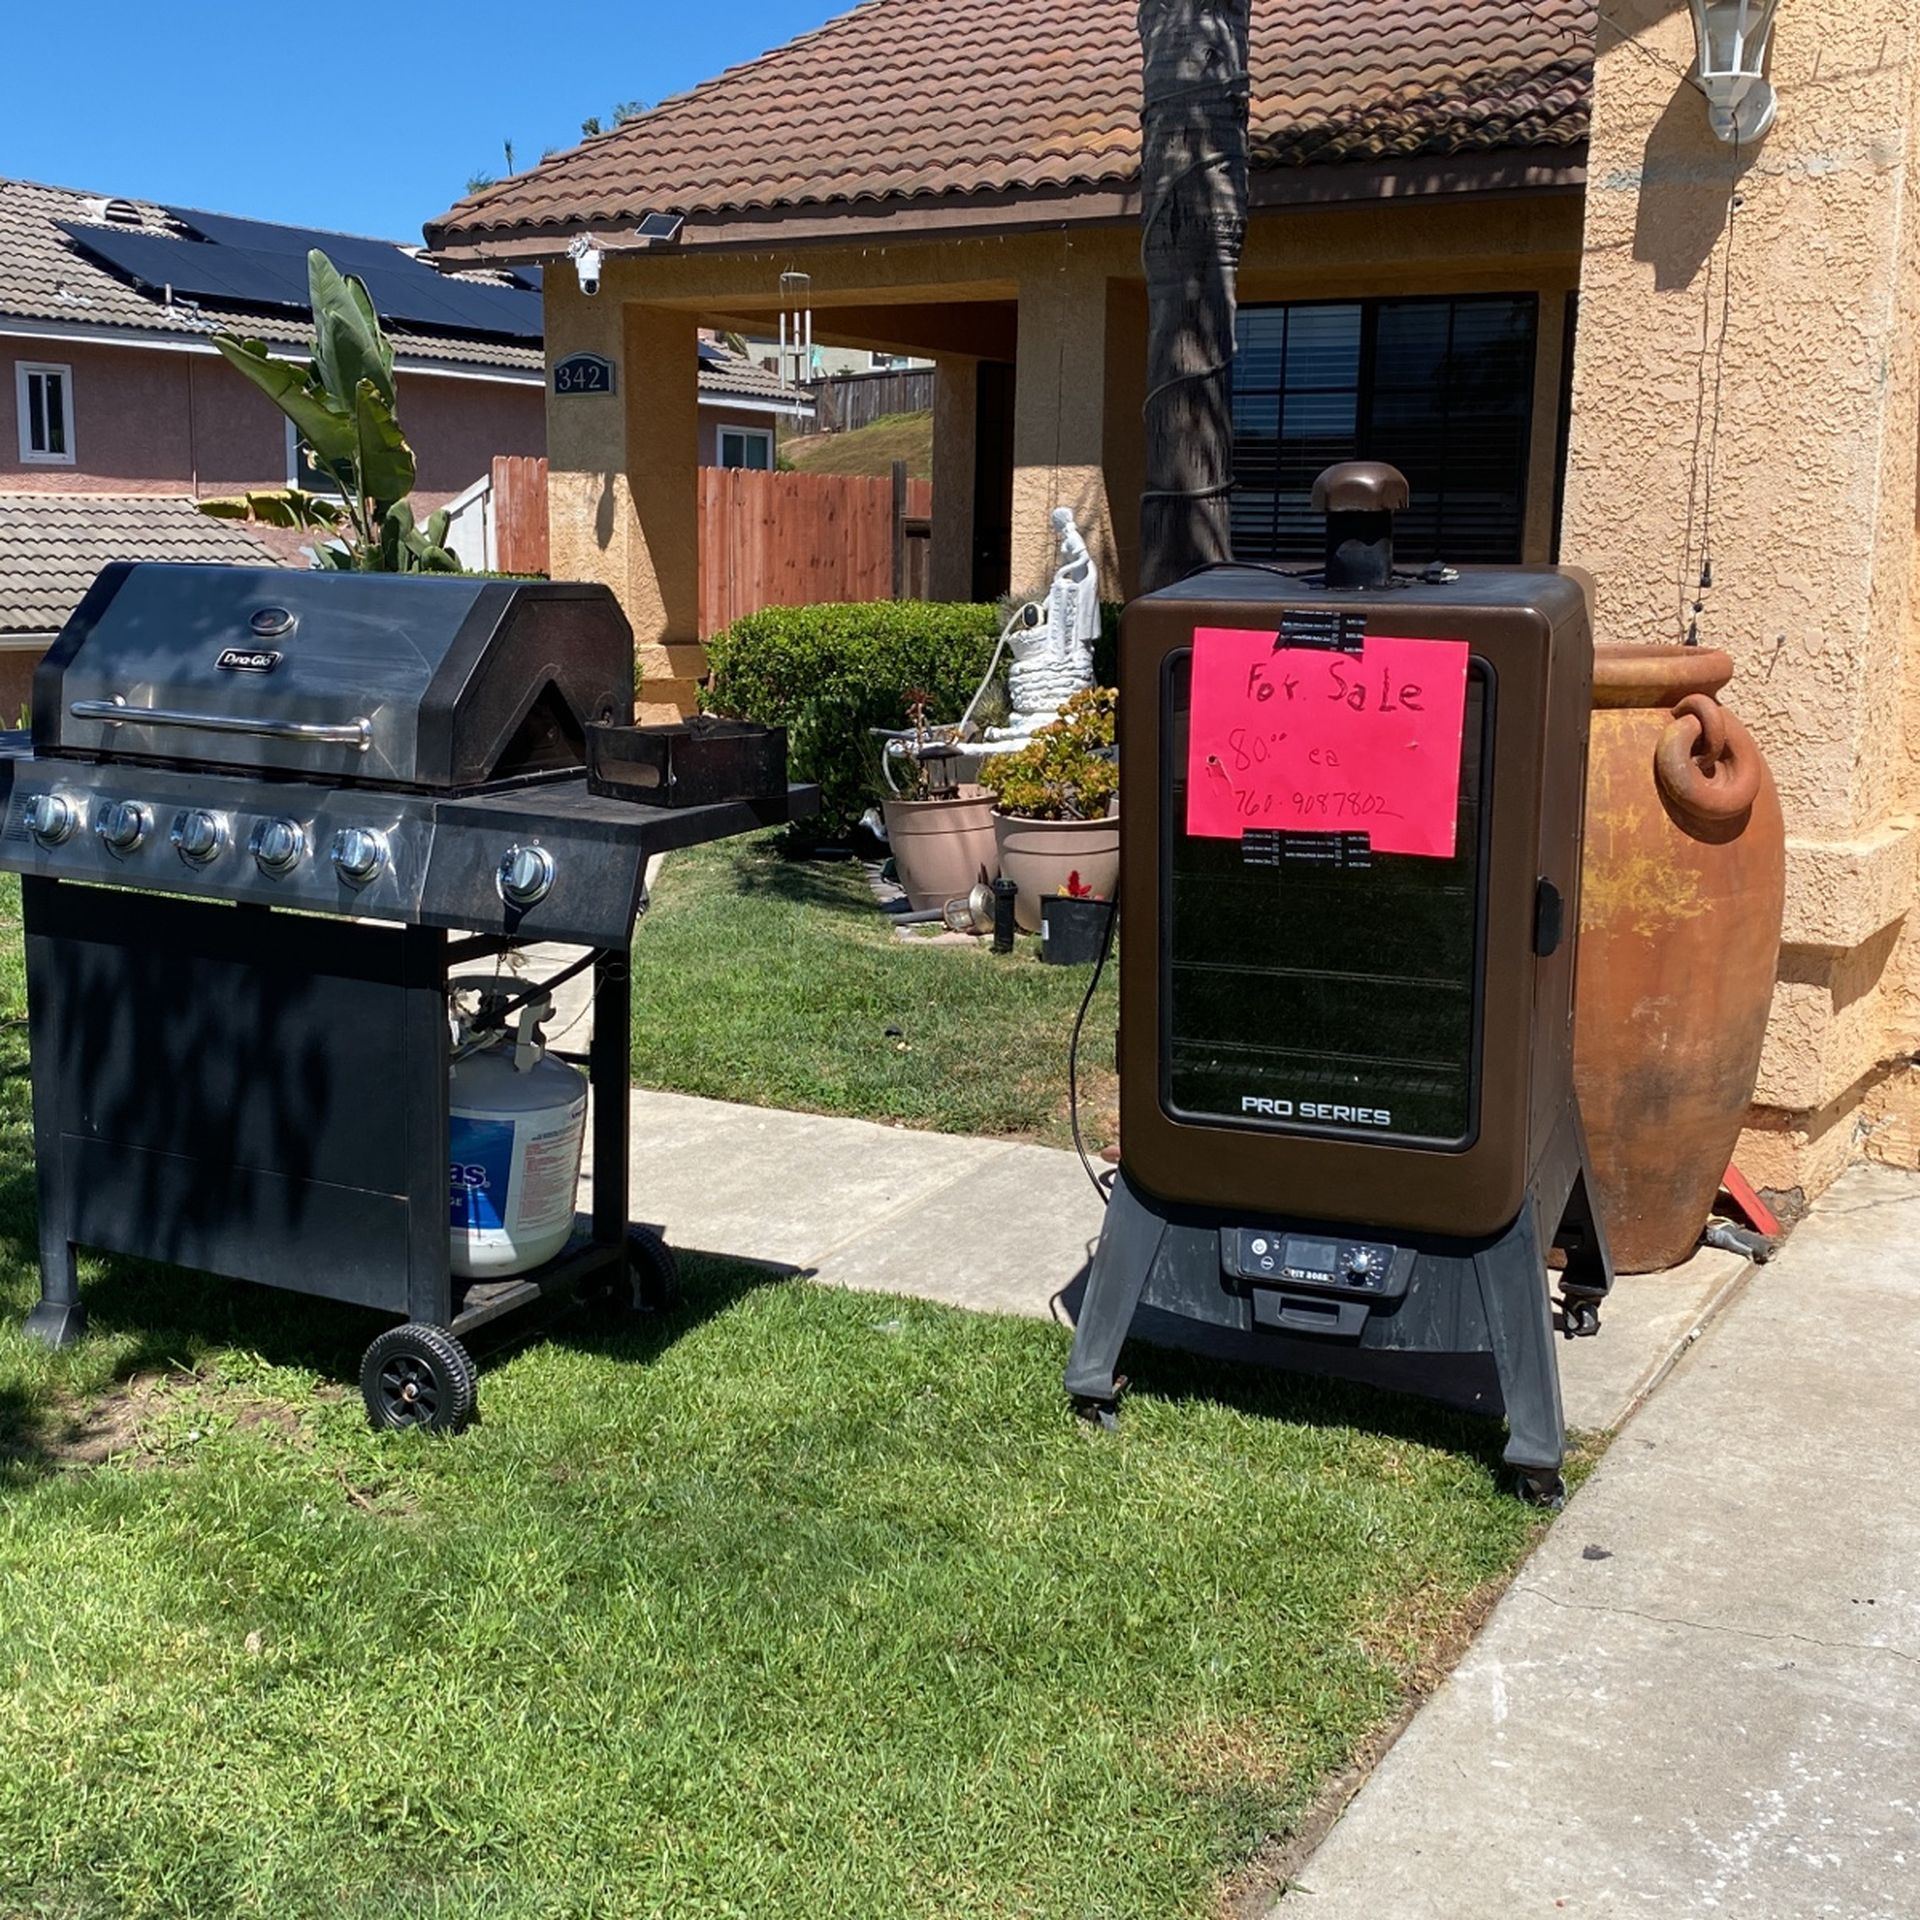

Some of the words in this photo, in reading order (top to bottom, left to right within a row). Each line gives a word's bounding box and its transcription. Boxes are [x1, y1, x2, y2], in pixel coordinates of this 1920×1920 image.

[558, 365, 601, 390] 342
[1241, 1096, 1293, 1116] PRO
[1299, 1102, 1391, 1126] SERIES
